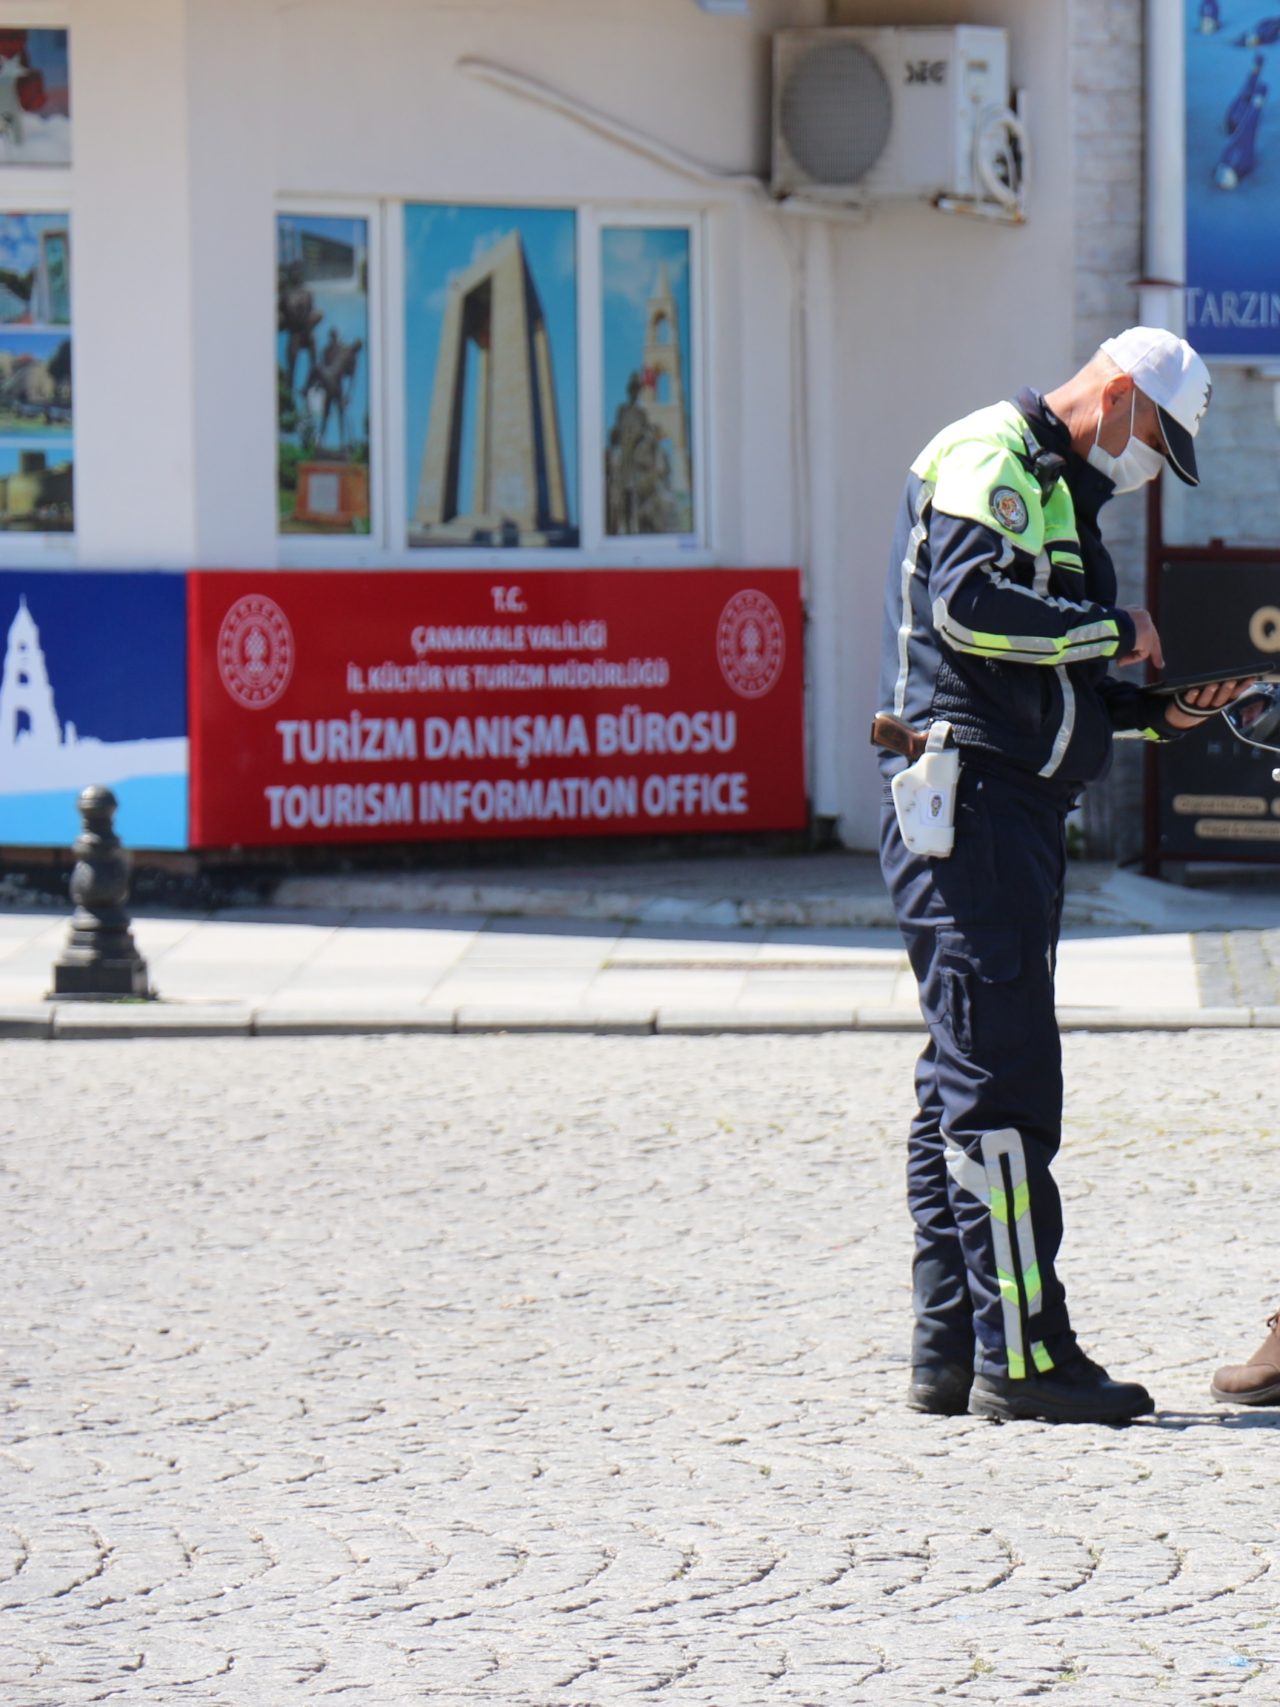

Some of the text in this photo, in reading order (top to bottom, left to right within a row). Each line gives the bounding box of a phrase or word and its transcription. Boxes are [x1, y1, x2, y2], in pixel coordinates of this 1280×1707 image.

[491, 586, 527, 612] T.C.
[411, 619, 607, 658] ÇANAKKALE VALİLİĞİ
[346, 657, 670, 693] İL KÜLTÜR VE TURİZM MÜDÜRLÜĞÜ
[275, 704, 736, 768] TURİZM DANIŞMA BÜROSU
[264, 772, 748, 830] TOURISM INFORMATION OFFICE
